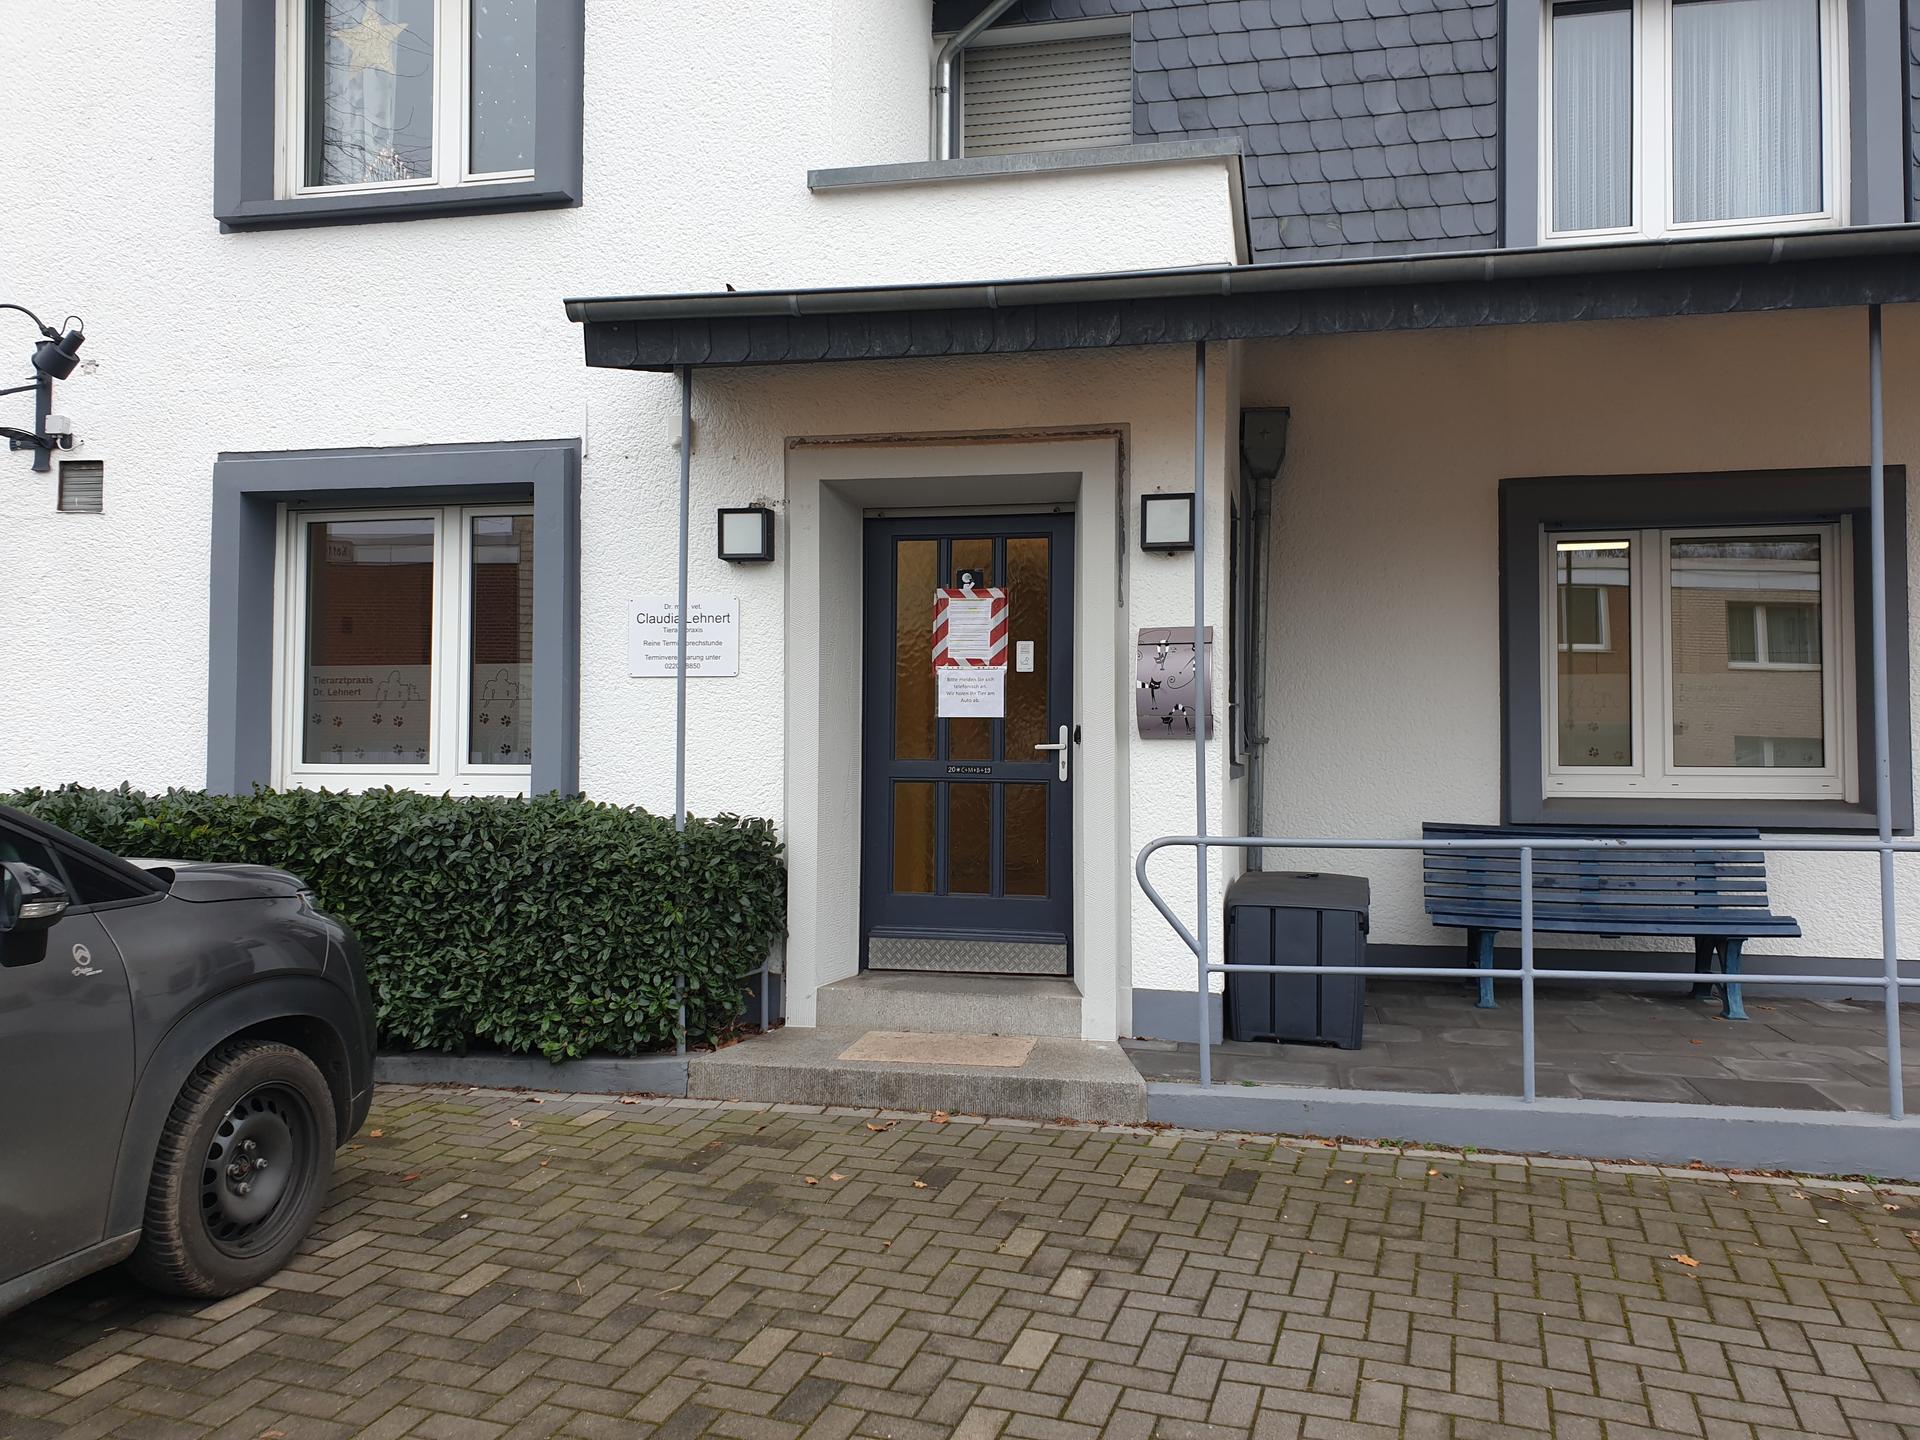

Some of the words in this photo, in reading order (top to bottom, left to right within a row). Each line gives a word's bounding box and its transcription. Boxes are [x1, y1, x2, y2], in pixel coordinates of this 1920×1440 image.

[636, 613, 680, 624] Claudia
[312, 676, 374, 686] Tierarztpraxis
[312, 688, 325, 696] Dr.
[327, 688, 361, 696] Lehnert
